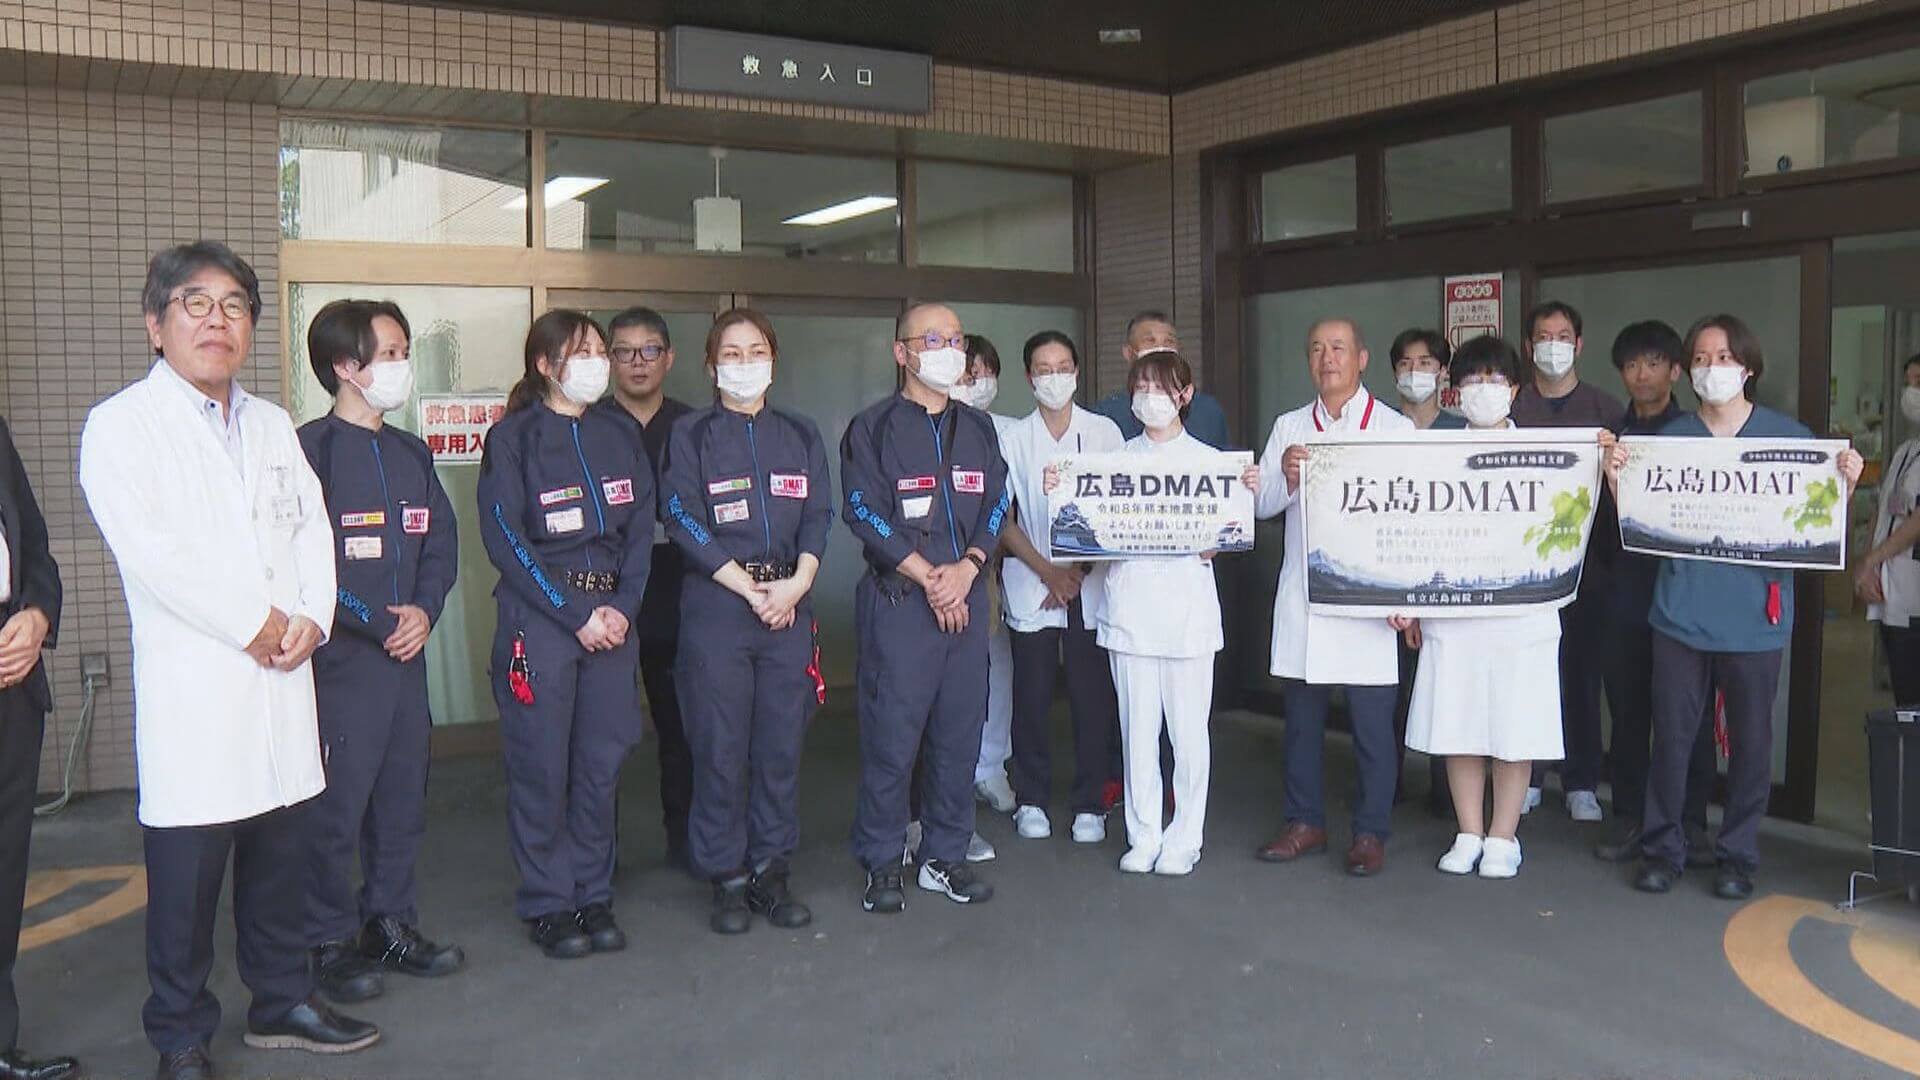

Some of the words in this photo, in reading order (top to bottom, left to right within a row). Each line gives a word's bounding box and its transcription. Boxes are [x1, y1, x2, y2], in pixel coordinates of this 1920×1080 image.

[742, 54, 872, 86] 救急入口
[1075, 473, 1238, 498] 広島DMAT
[1340, 476, 1545, 514] 広島DMAT
[1644, 465, 1801, 495] 広島DMAT
[1097, 503, 1218, 515] 令和8年熊本地震支援
